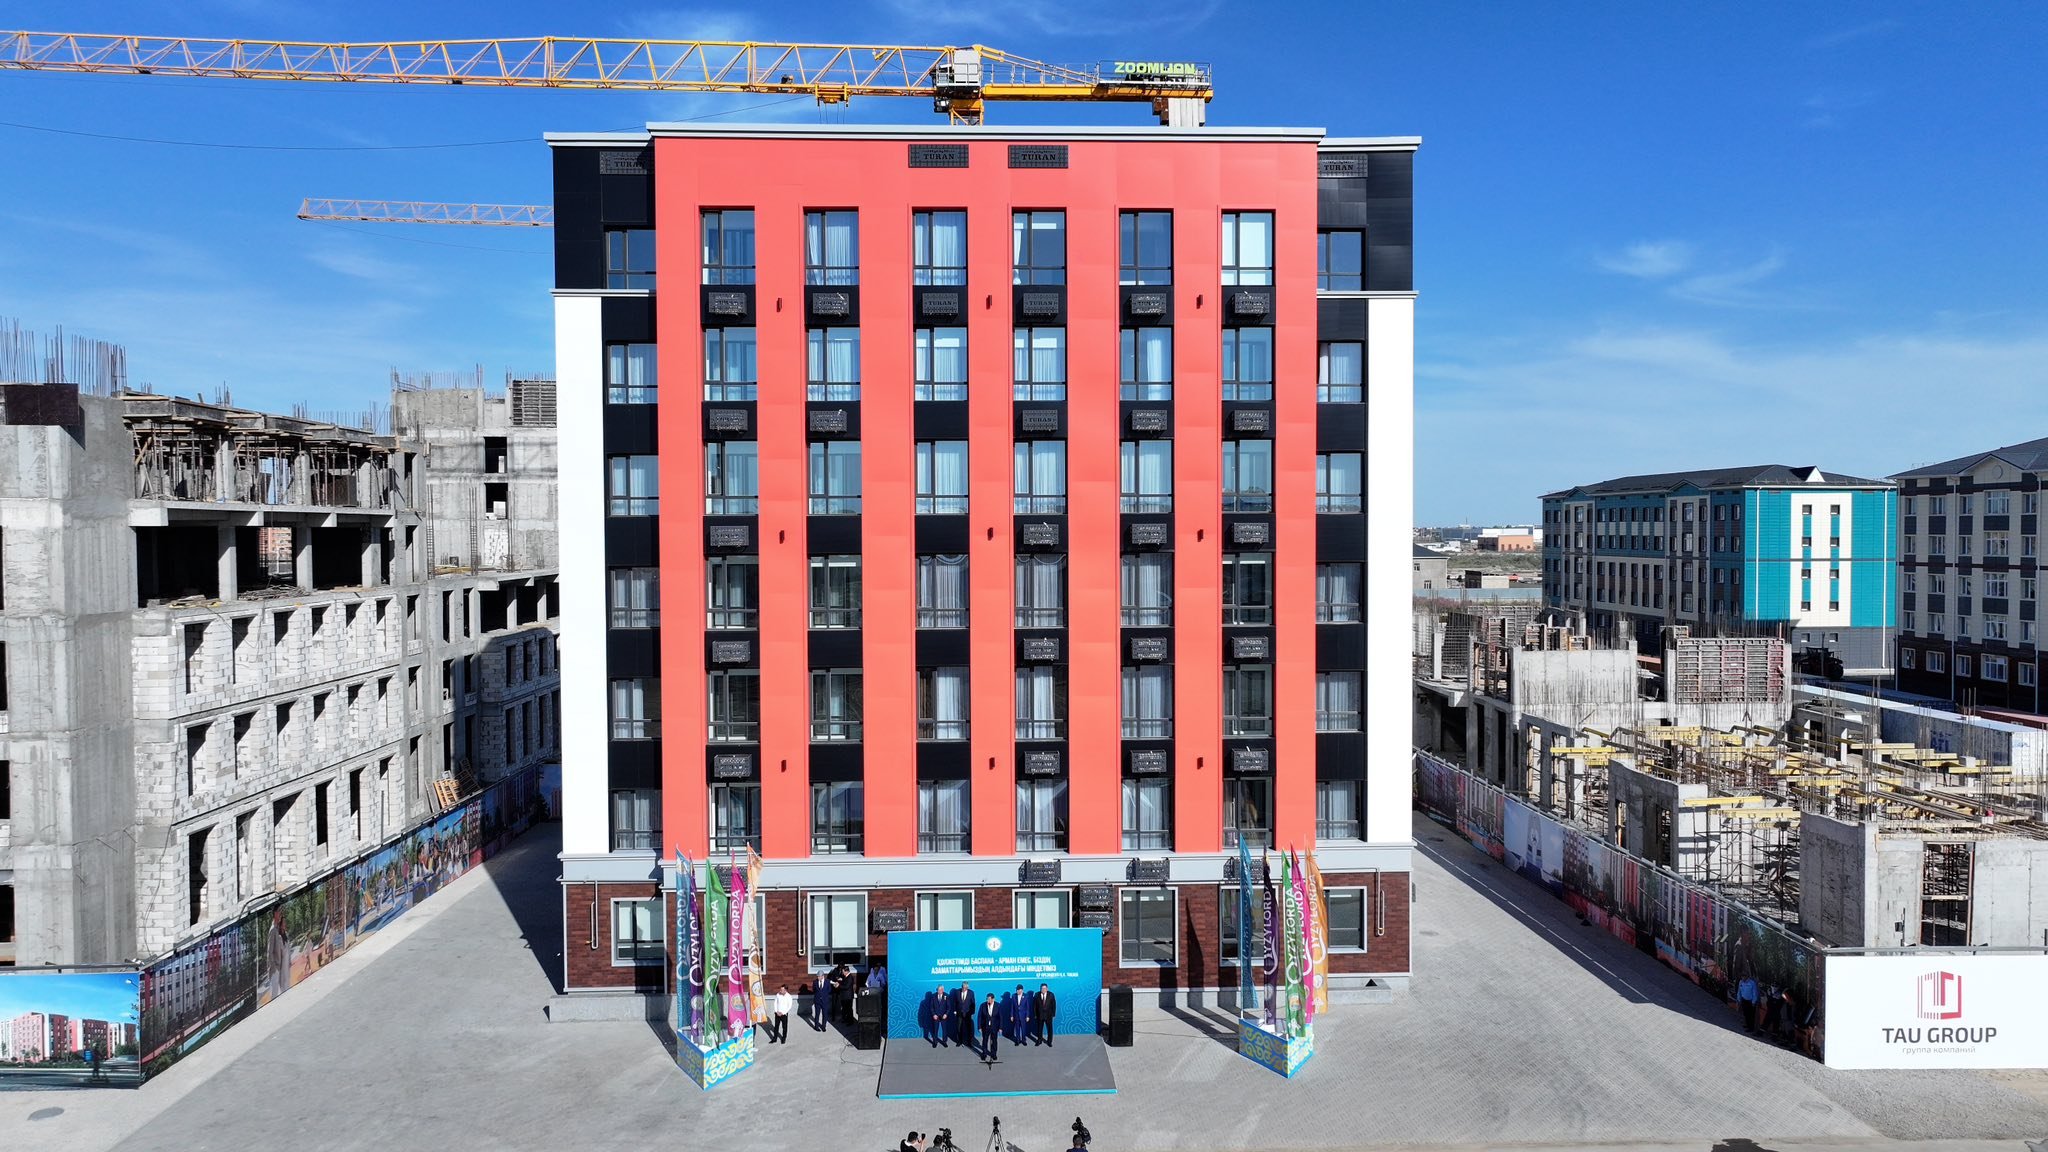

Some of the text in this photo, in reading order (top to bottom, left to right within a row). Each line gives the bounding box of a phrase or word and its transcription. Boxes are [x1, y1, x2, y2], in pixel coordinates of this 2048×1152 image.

[1114, 61, 1196, 74] ZOOMLION
[1021, 153, 1056, 161] TURAN
[1263, 886, 1278, 975] QYZYLORD
[1286, 887, 1302, 986] QYZYLORDA
[1882, 1027, 1997, 1043] TAU GROUP
[1902, 1046, 1976, 1055] группа компаний
